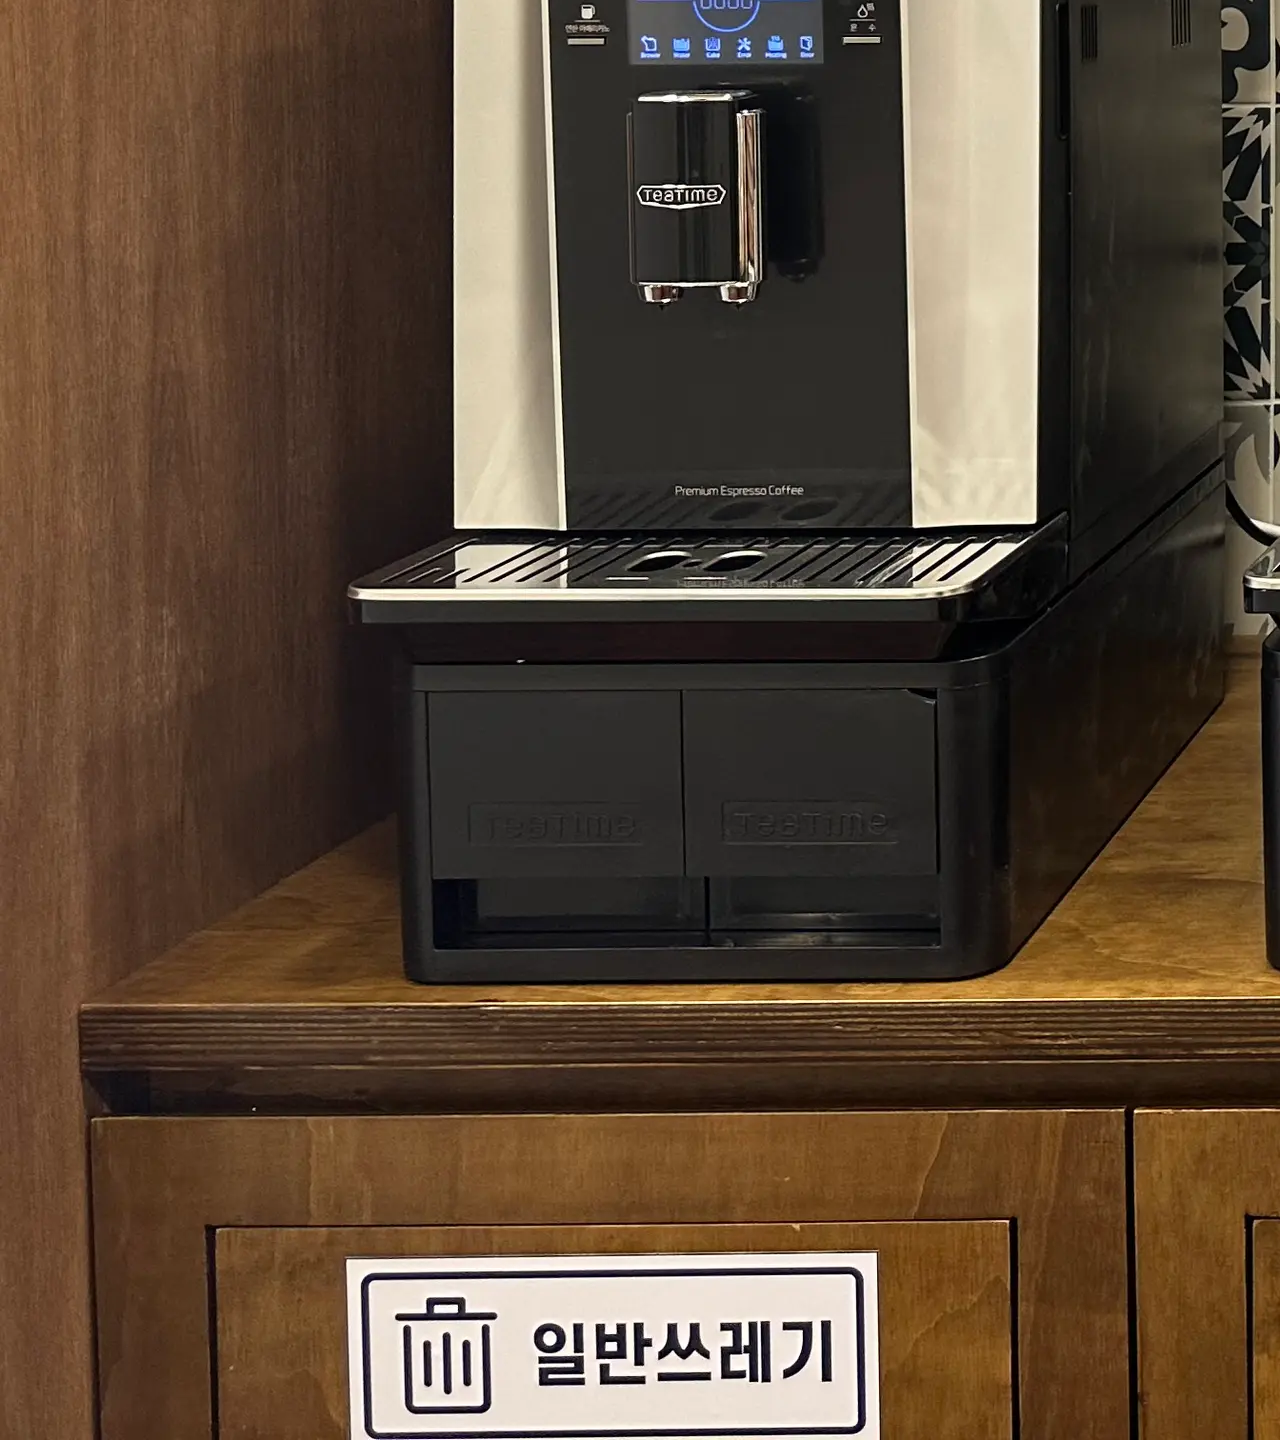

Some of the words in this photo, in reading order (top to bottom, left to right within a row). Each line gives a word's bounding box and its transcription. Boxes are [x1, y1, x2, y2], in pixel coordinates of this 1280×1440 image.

[675, 486, 719, 497] Premium
[720, 486, 767, 497] Espresso
[769, 486, 804, 497] Coffee
[533, 1320, 832, 1386] 일반쓰레기
